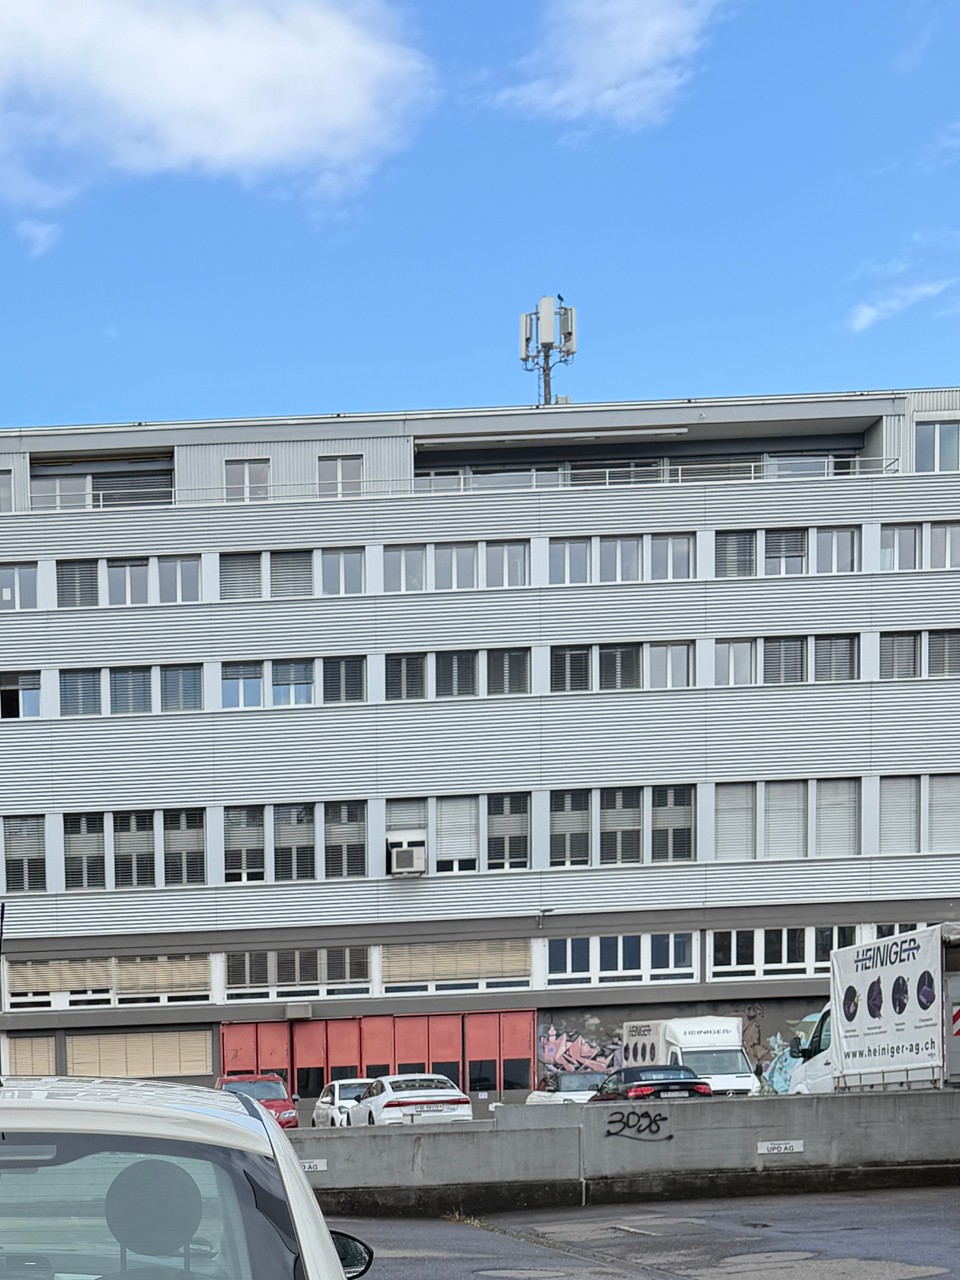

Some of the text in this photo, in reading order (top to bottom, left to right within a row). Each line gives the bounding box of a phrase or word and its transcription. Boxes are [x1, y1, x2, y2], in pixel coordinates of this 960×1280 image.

[855, 937, 921, 972] HEINIGER
[843, 1037, 936, 1060] www.heiniger-ag.ch
[783, 1144, 794, 1152] AG
